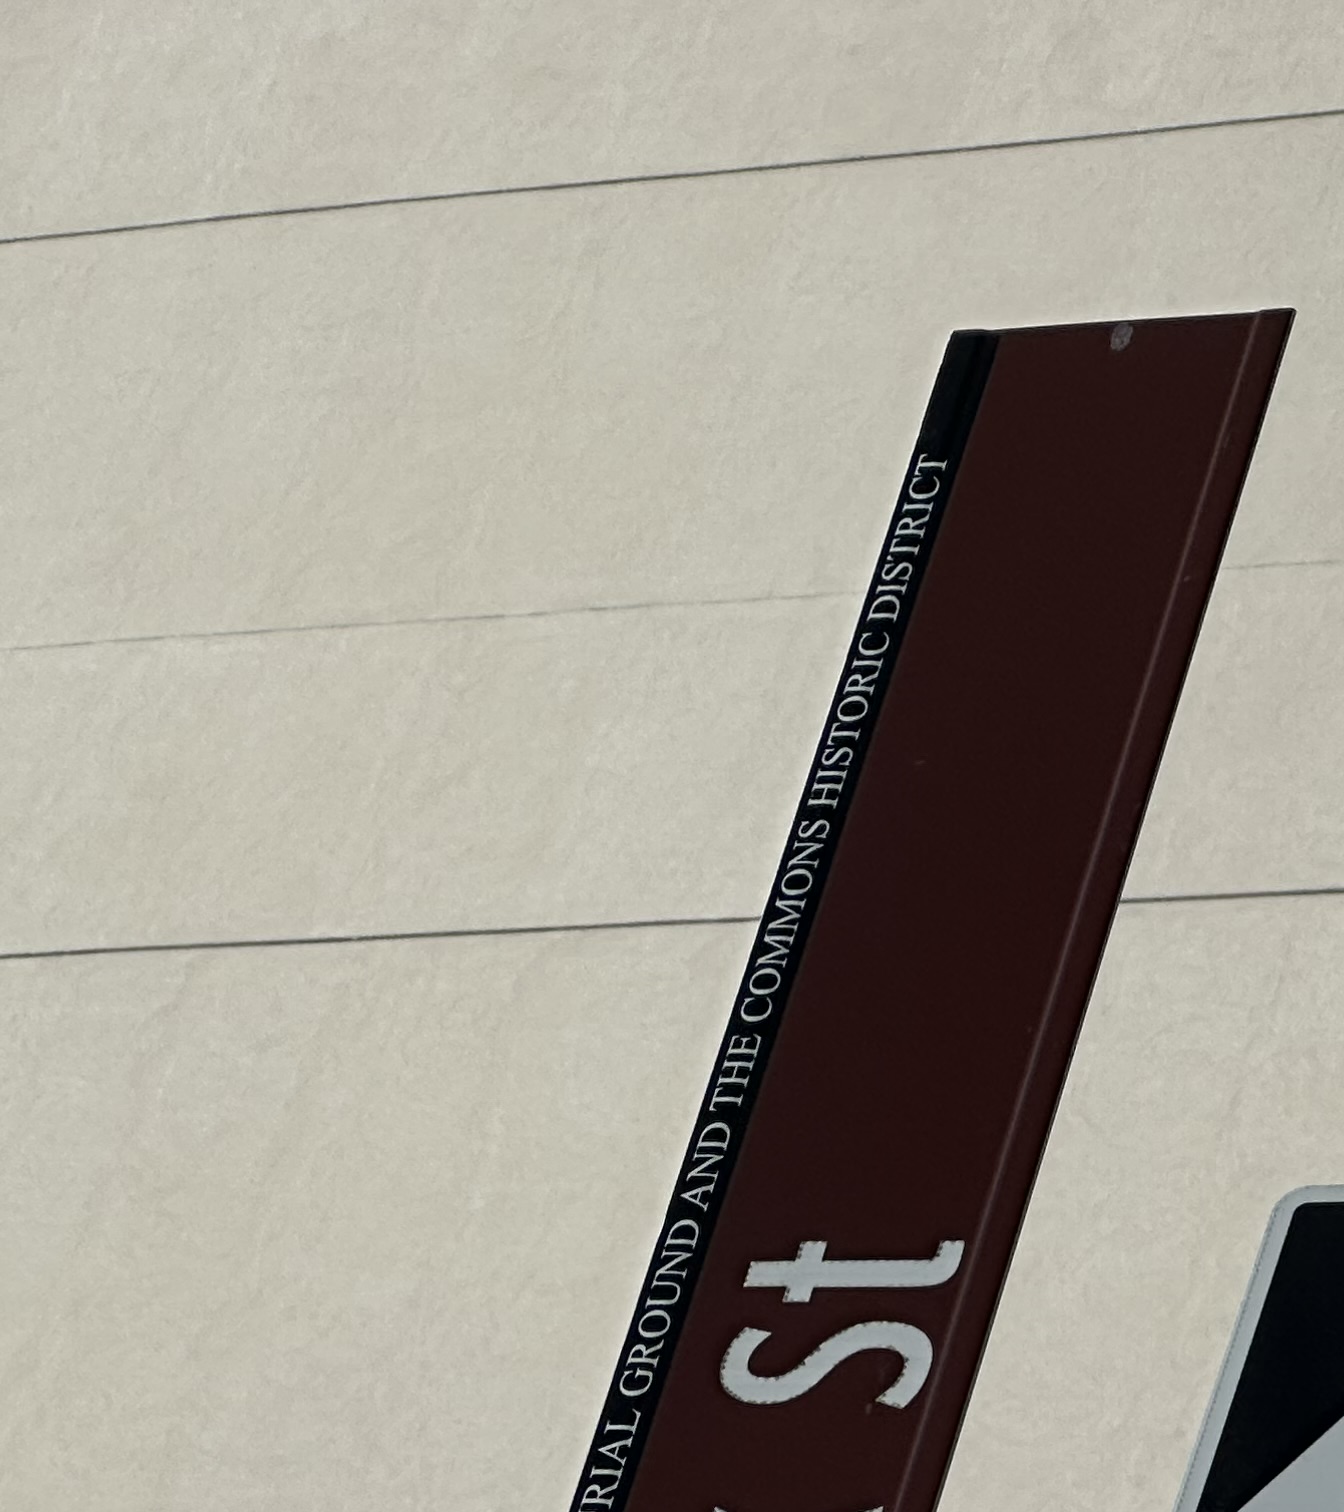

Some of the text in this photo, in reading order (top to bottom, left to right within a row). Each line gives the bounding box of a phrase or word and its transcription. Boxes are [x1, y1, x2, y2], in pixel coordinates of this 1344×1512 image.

[619, 1219, 700, 1397] GROUND
[681, 1121, 731, 1212] AND
[709, 1034, 762, 1111] THE
[741, 819, 830, 1023] COMMONS
[807, 632, 890, 809] HISTORIC
[866, 453, 948, 623] DISTRICT
[720, 1240, 965, 1409] St
